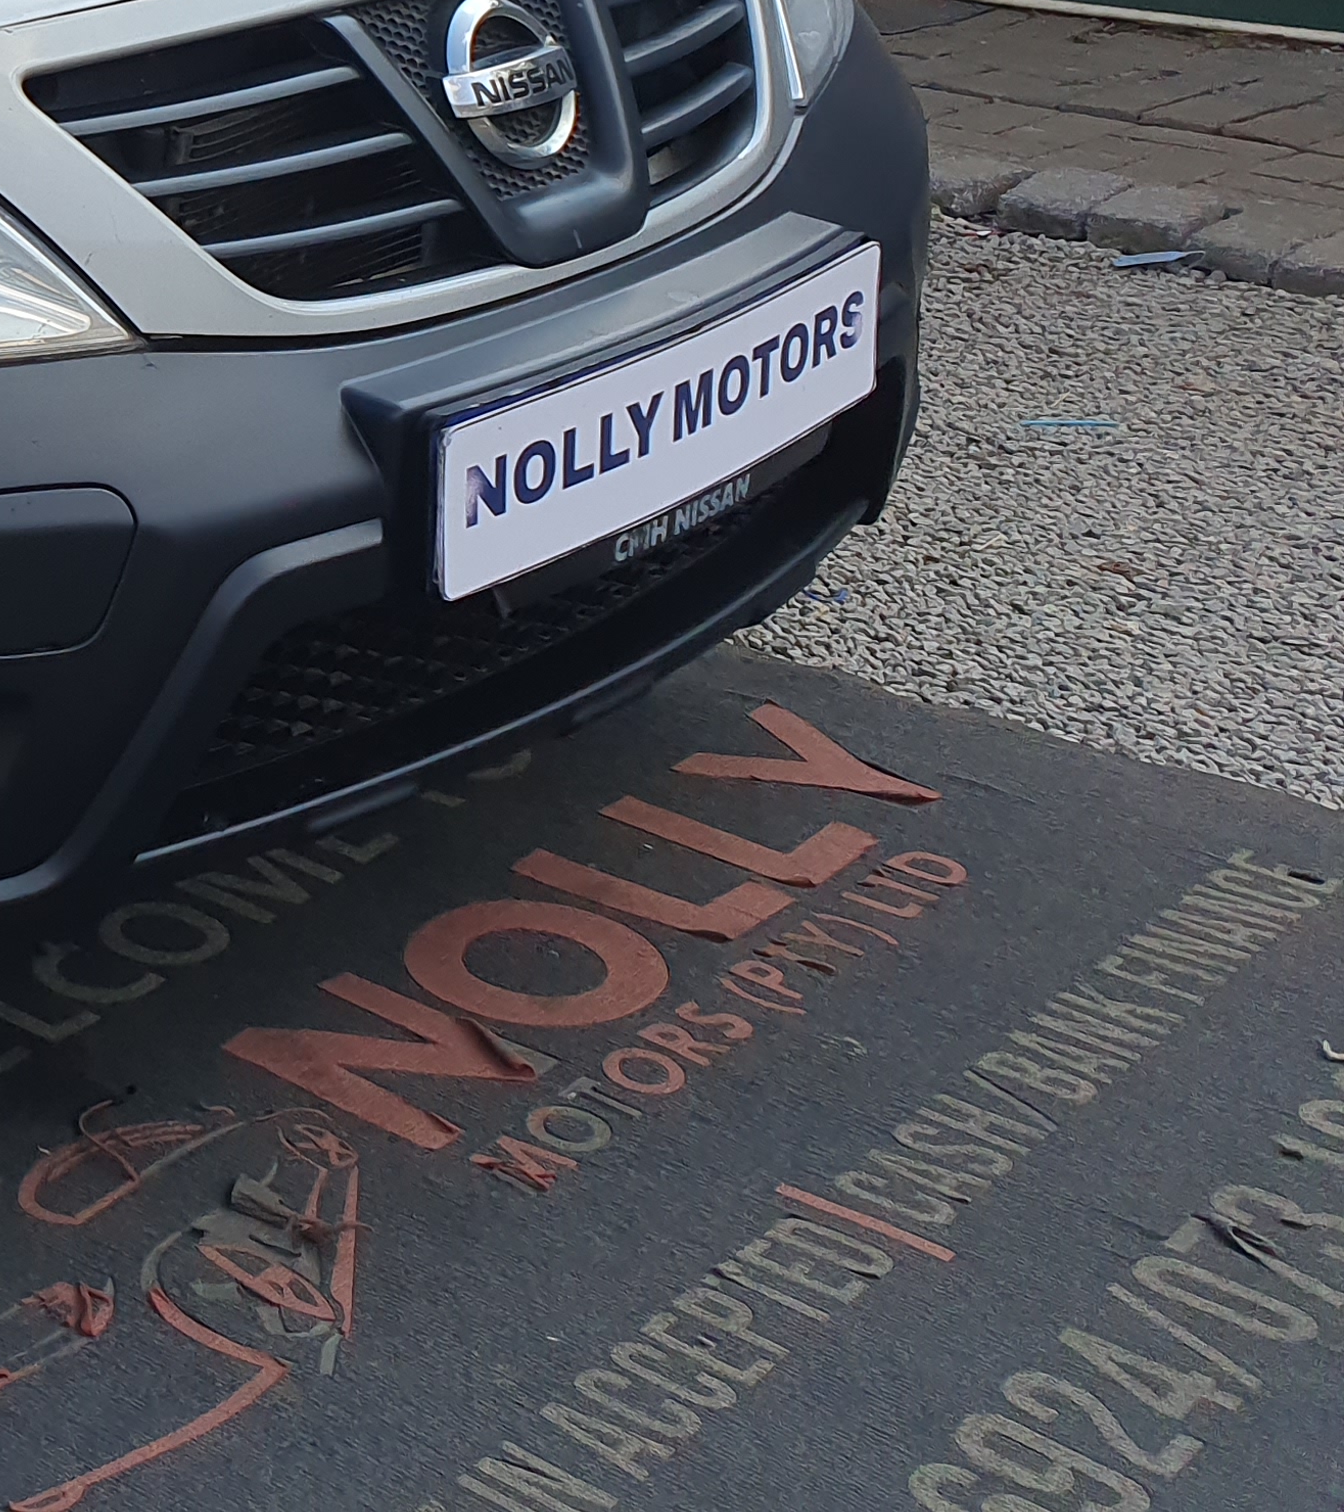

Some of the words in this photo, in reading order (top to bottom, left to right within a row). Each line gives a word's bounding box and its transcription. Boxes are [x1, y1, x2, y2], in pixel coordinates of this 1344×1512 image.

[470, 59, 575, 108] NISSAN
[465, 391, 665, 529] NOLLY
[671, 290, 864, 444] MOTORS
[673, 473, 752, 536] NISSAN
[220, 699, 942, 1149] NOLLY
[468, 1000, 755, 1192] MOTORS
[840, 850, 969, 919] LTD
[539, 1214, 896, 1482] ACCEPTED
